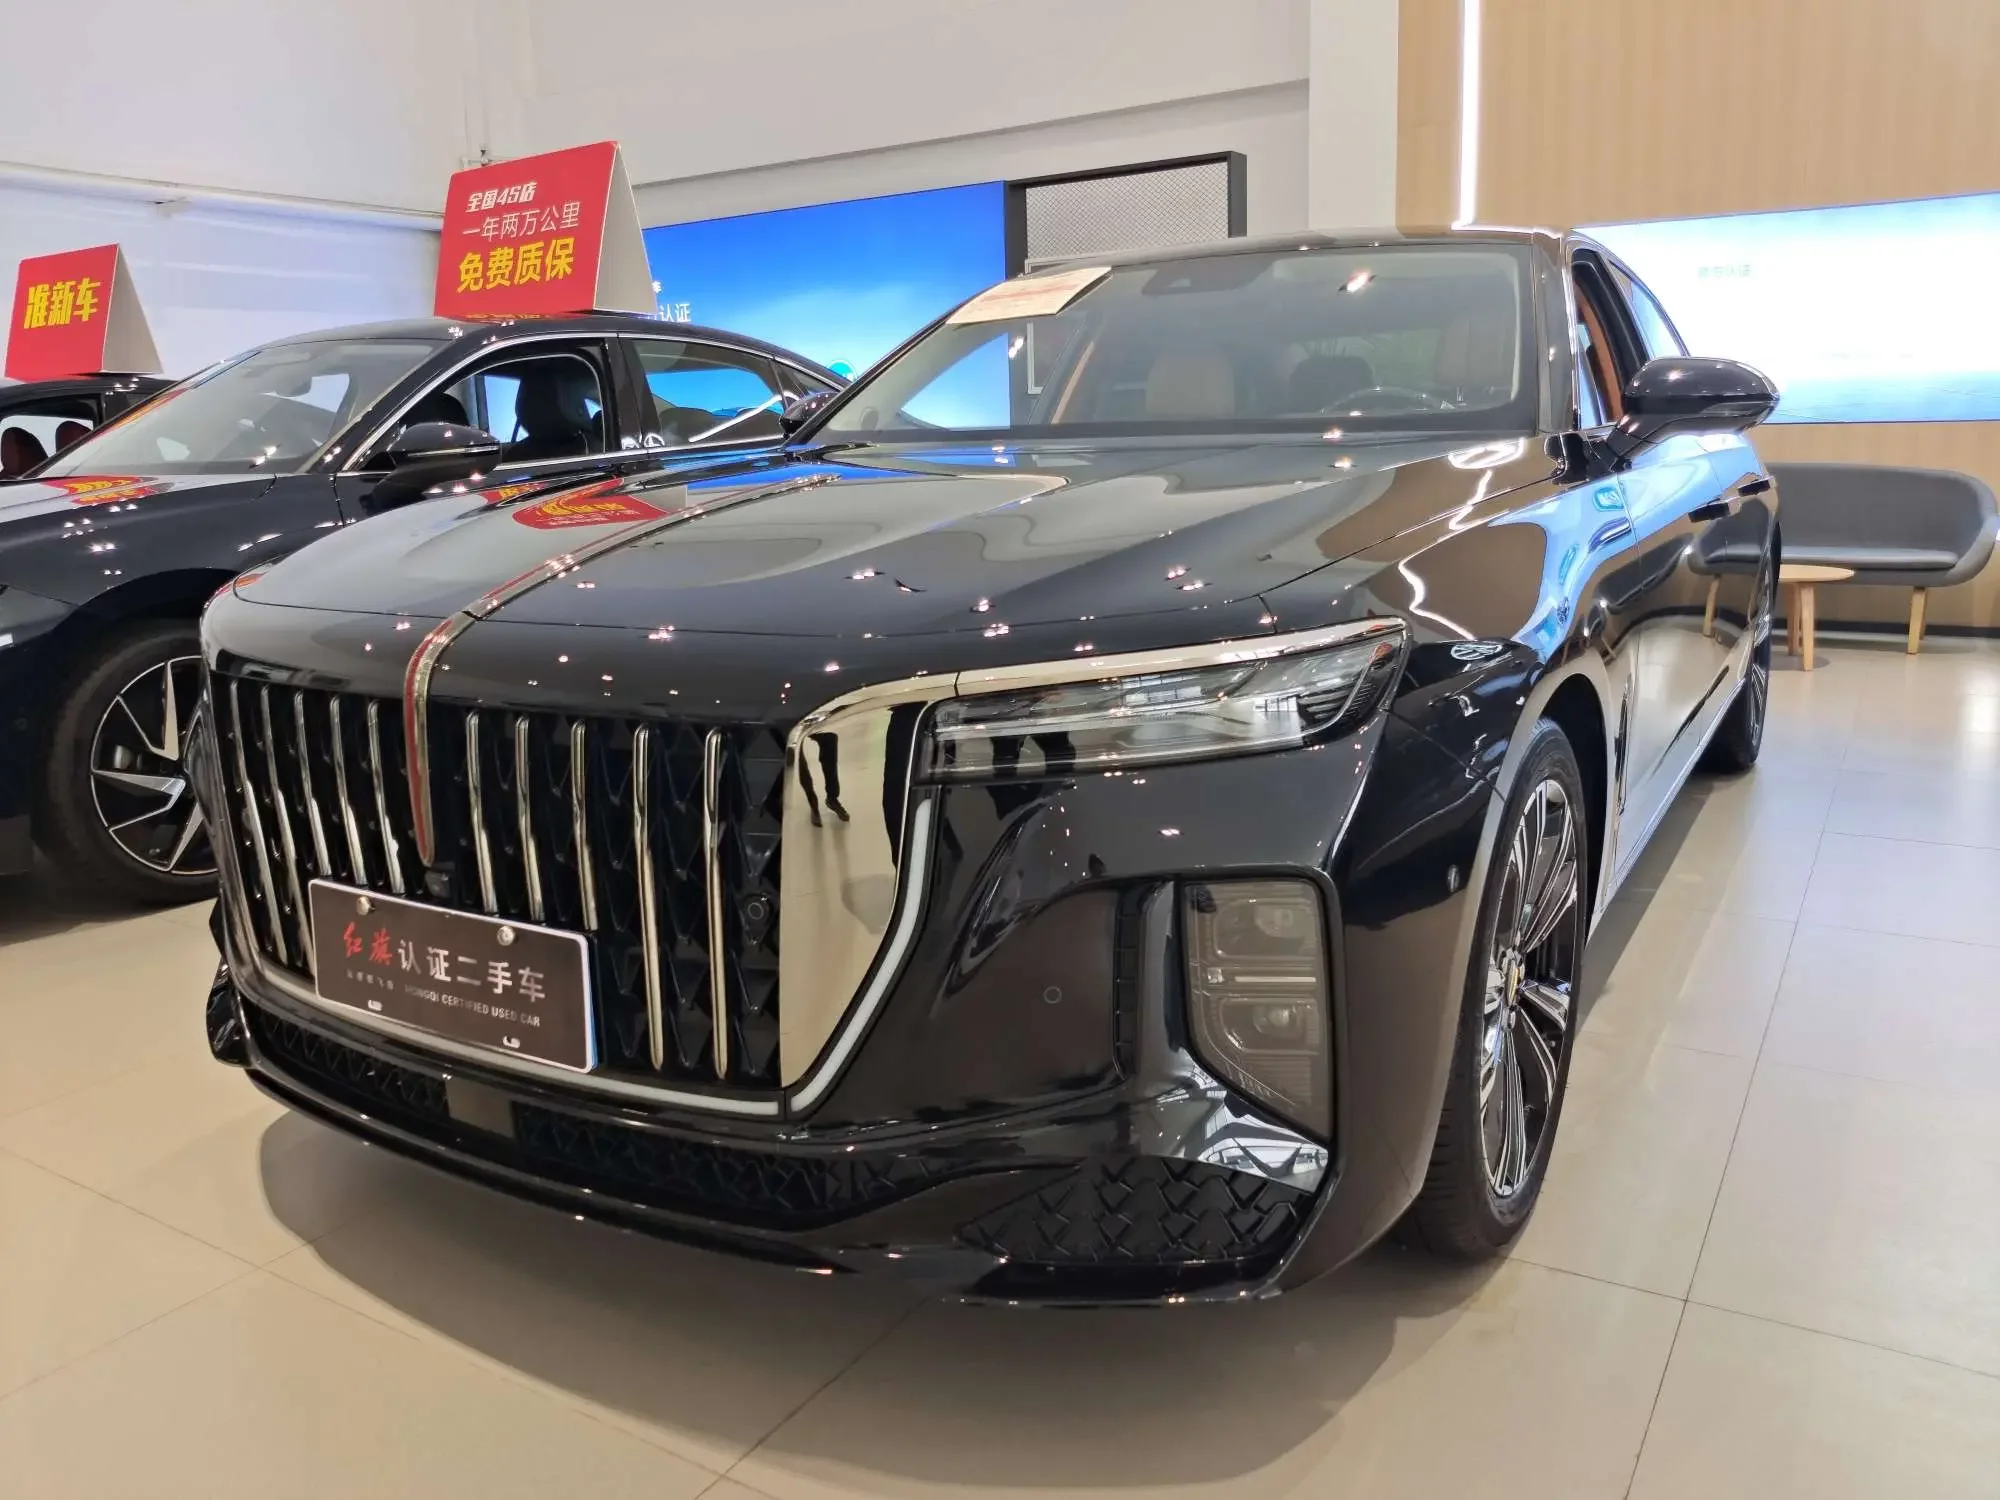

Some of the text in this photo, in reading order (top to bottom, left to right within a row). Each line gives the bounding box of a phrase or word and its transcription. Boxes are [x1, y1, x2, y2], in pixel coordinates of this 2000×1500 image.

[465, 181, 538, 213] 全国4S店
[462, 201, 580, 242] 一年两万公里
[456, 237, 575, 293] 免费质保
[23, 277, 101, 329] 准新车
[655, 303, 692, 322] 认证
[405, 984, 541, 1027] HONGQI CERTIFIED USED CAR
